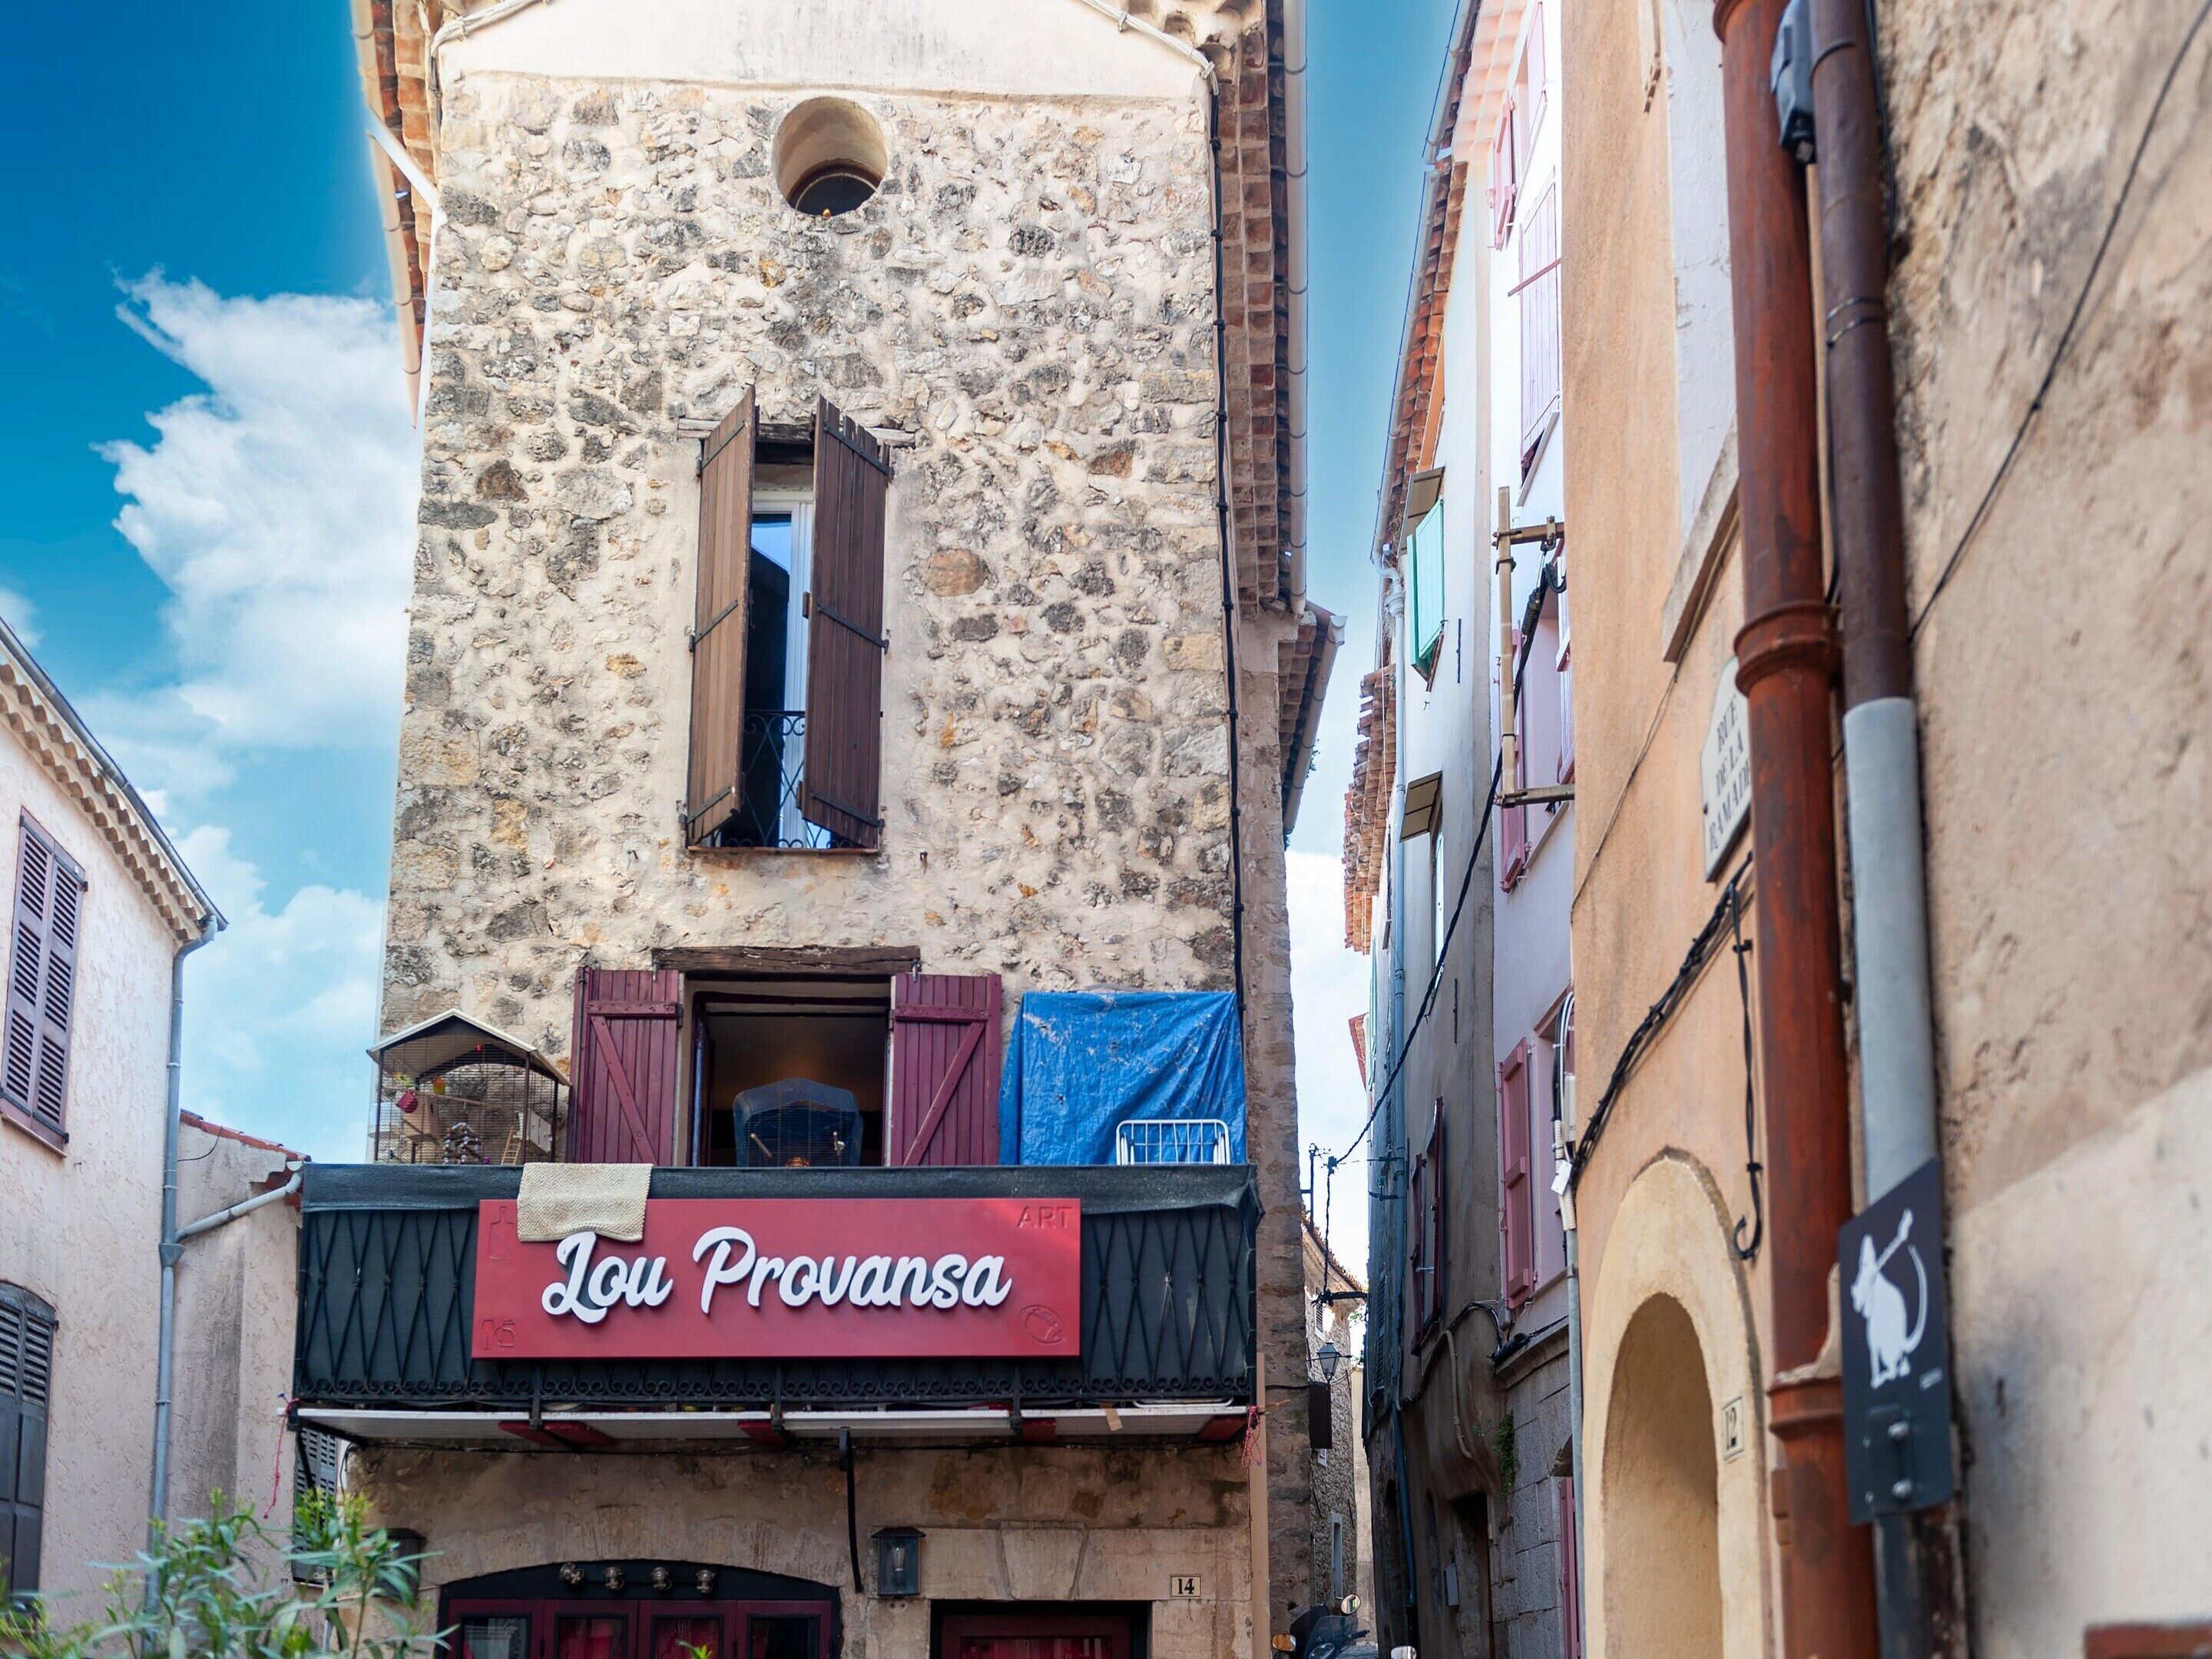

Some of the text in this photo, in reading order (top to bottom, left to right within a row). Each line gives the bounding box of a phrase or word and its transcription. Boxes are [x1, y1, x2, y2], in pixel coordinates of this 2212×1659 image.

[1717, 694, 1737, 753] RUE
[1017, 1204, 1072, 1229] ART
[541, 1226, 1012, 1323] Lou Provansa
[1725, 1406, 1737, 1451] 12
[1177, 1578, 1195, 1594] 14
